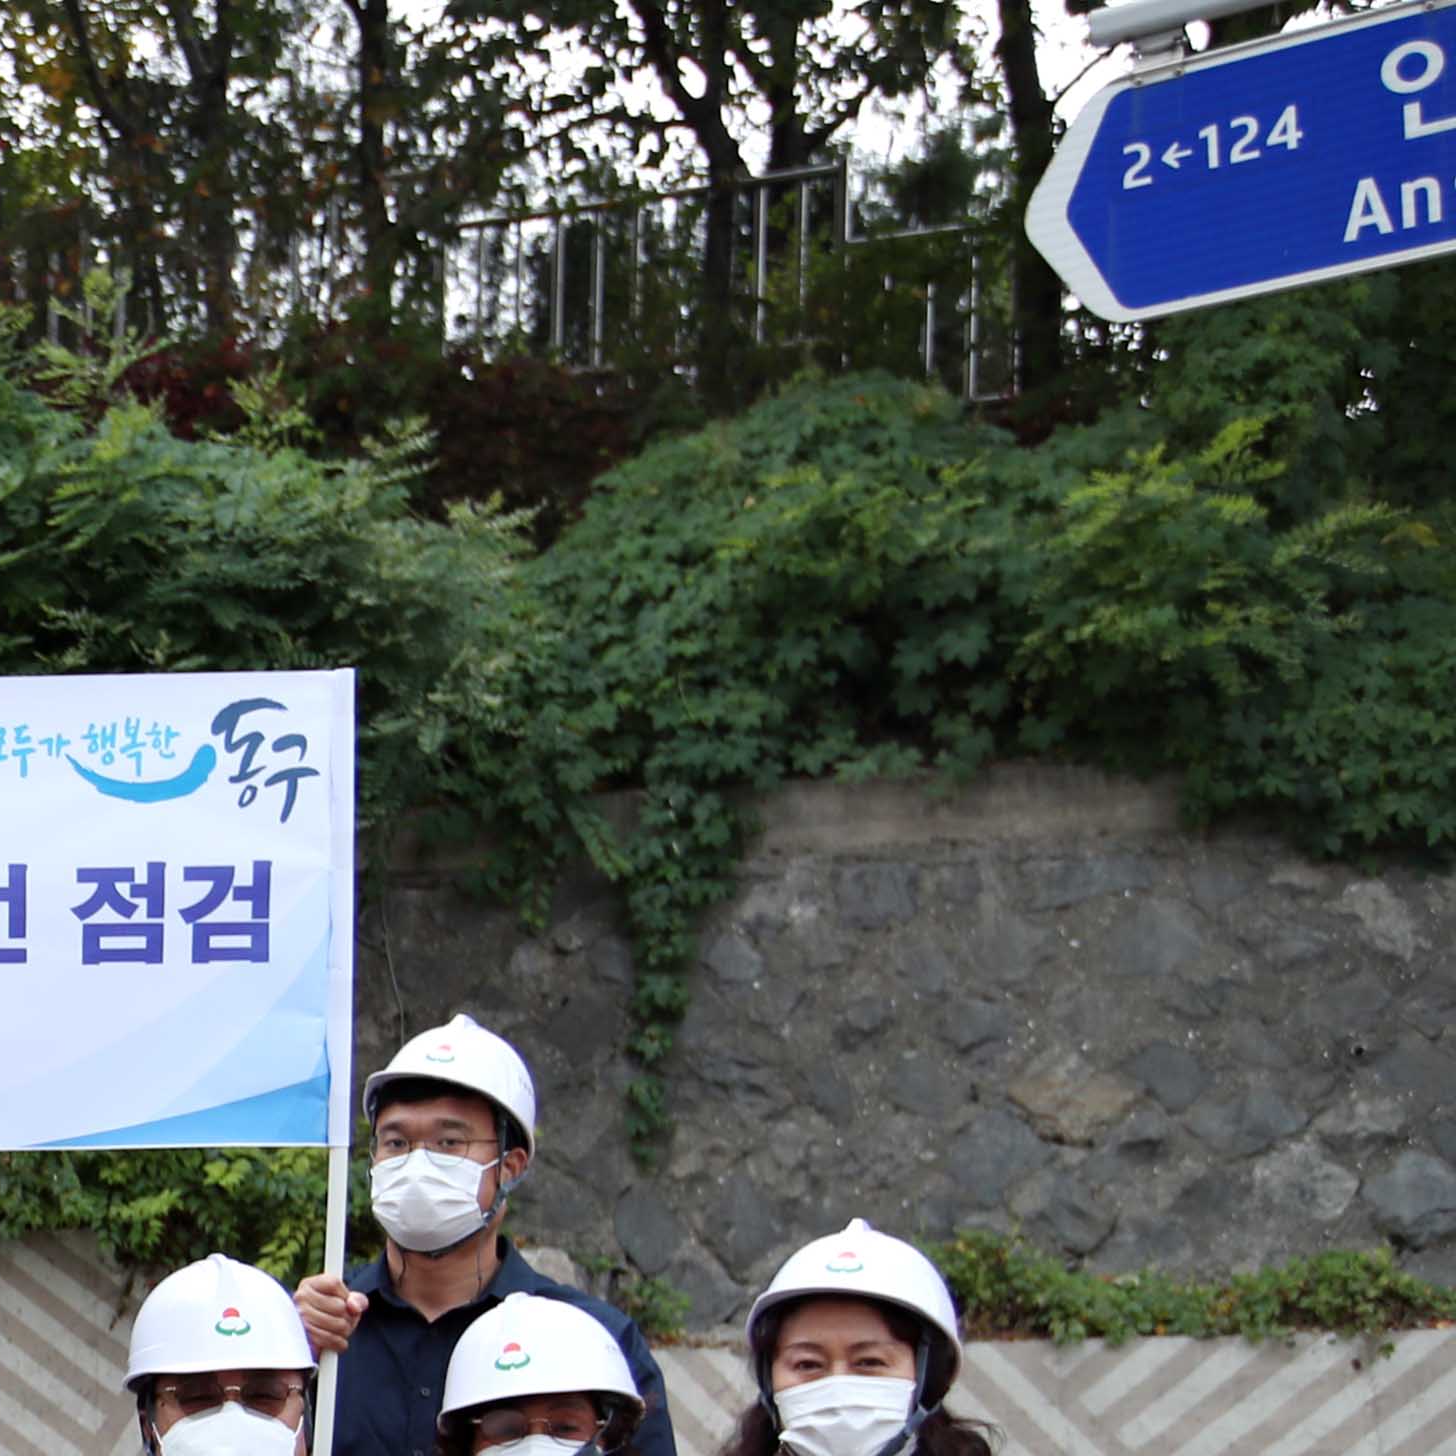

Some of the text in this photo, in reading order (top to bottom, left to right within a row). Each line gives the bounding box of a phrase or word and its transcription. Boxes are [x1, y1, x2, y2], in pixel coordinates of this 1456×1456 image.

[1343, 174, 1456, 243] An
[81, 715, 182, 777] 행복한
[210, 696, 321, 825] 동구
[69, 859, 273, 967] 점검
